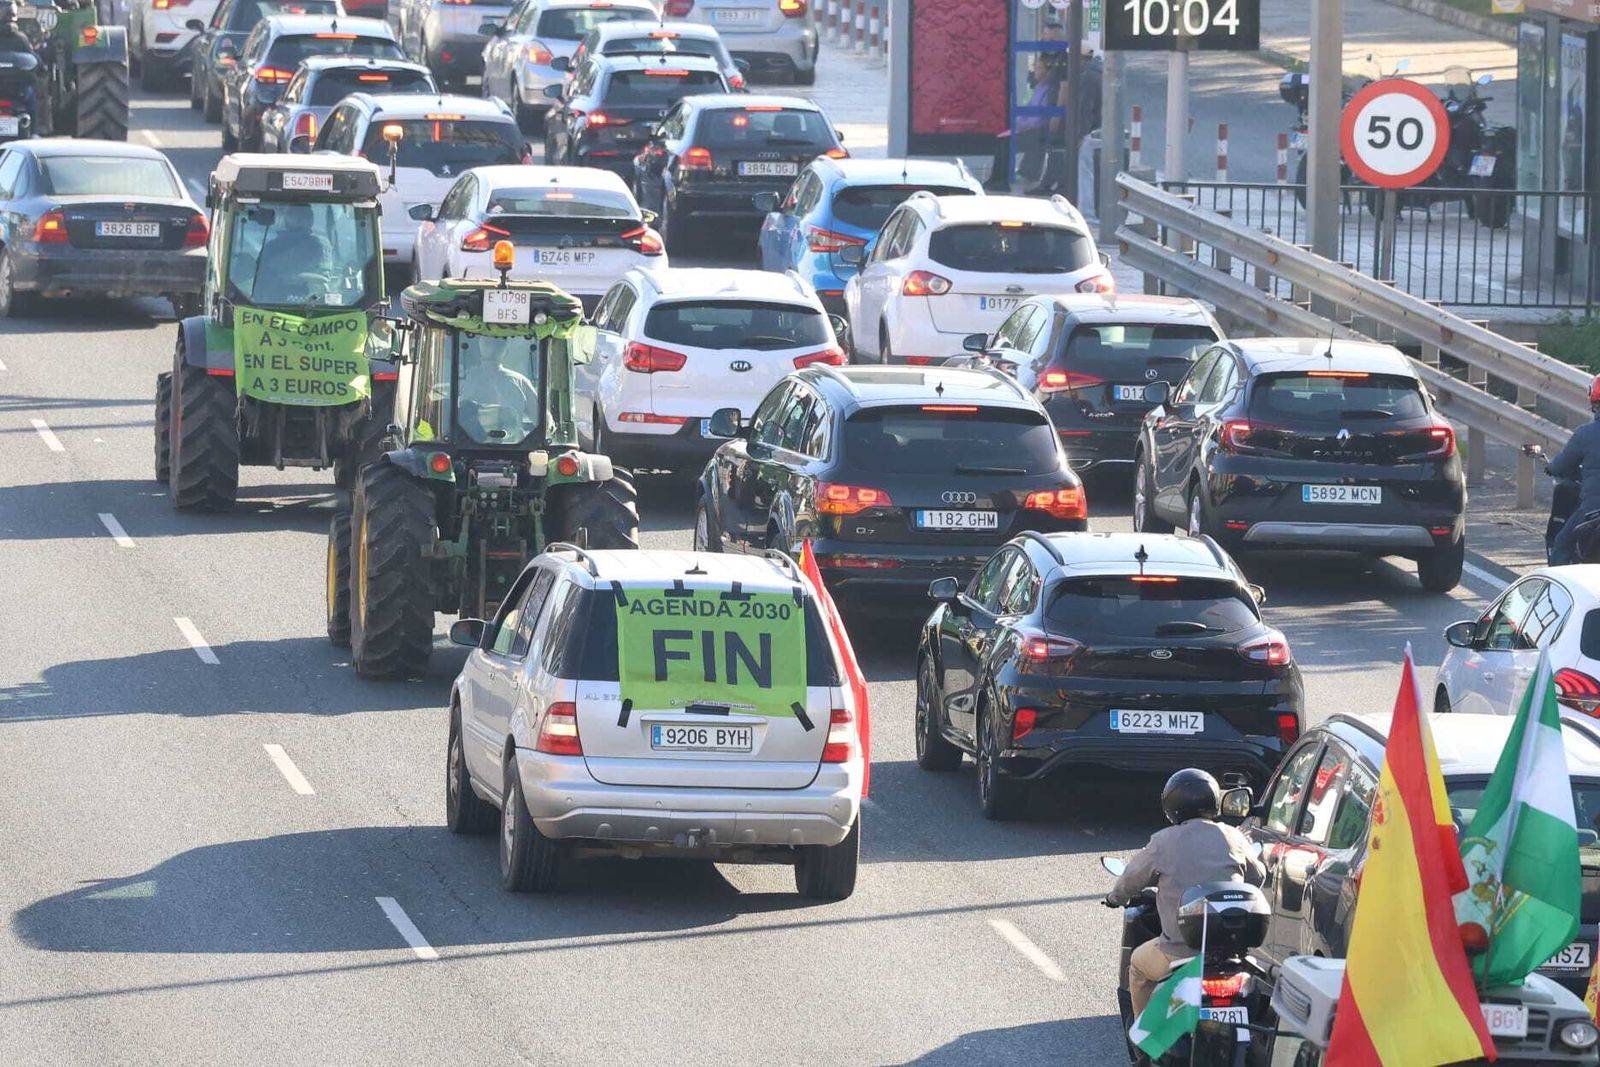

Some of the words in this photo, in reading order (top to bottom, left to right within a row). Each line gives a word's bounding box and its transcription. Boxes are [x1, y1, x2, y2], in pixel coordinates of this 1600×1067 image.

[1123, 0, 1240, 36] 10:04
[1367, 115, 1424, 151] 50
[746, 162, 772, 175] 3894
[103, 223, 132, 236] 3826
[136, 224, 157, 236] BRF
[541, 251, 571, 263] 6746
[574, 252, 596, 263] MFP
[488, 291, 495, 303] E
[501, 292, 527, 304] 0798
[988, 297, 1019, 309] 0177
[497, 309, 518, 321] BFS
[242, 311, 264, 325] EN
[269, 315, 291, 333] EL
[297, 318, 358, 336] CAMPO
[260, 331, 273, 347] A
[291, 340, 335, 352] ent.
[243, 353, 265, 369] EN
[271, 355, 294, 371] EL
[299, 356, 358, 375] SUPER
[732, 362, 750, 371] KIA
[252, 376, 265, 392] A
[269, 378, 280, 392] 3
[285, 378, 348, 396] EUROS
[1311, 487, 1347, 500] 5892
[1351, 488, 1378, 501] MCN
[928, 512, 963, 526] 1182
[968, 513, 996, 527] GHM
[629, 599, 734, 618] AGENDA
[739, 601, 791, 620] 2030
[652, 629, 772, 689] FIN
[1121, 712, 1163, 728] 6223
[1168, 714, 1199, 730] MHZ
[666, 728, 708, 745] 9206
[716, 729, 748, 746] BYH
[1211, 1010, 1243, 1024] 8781
